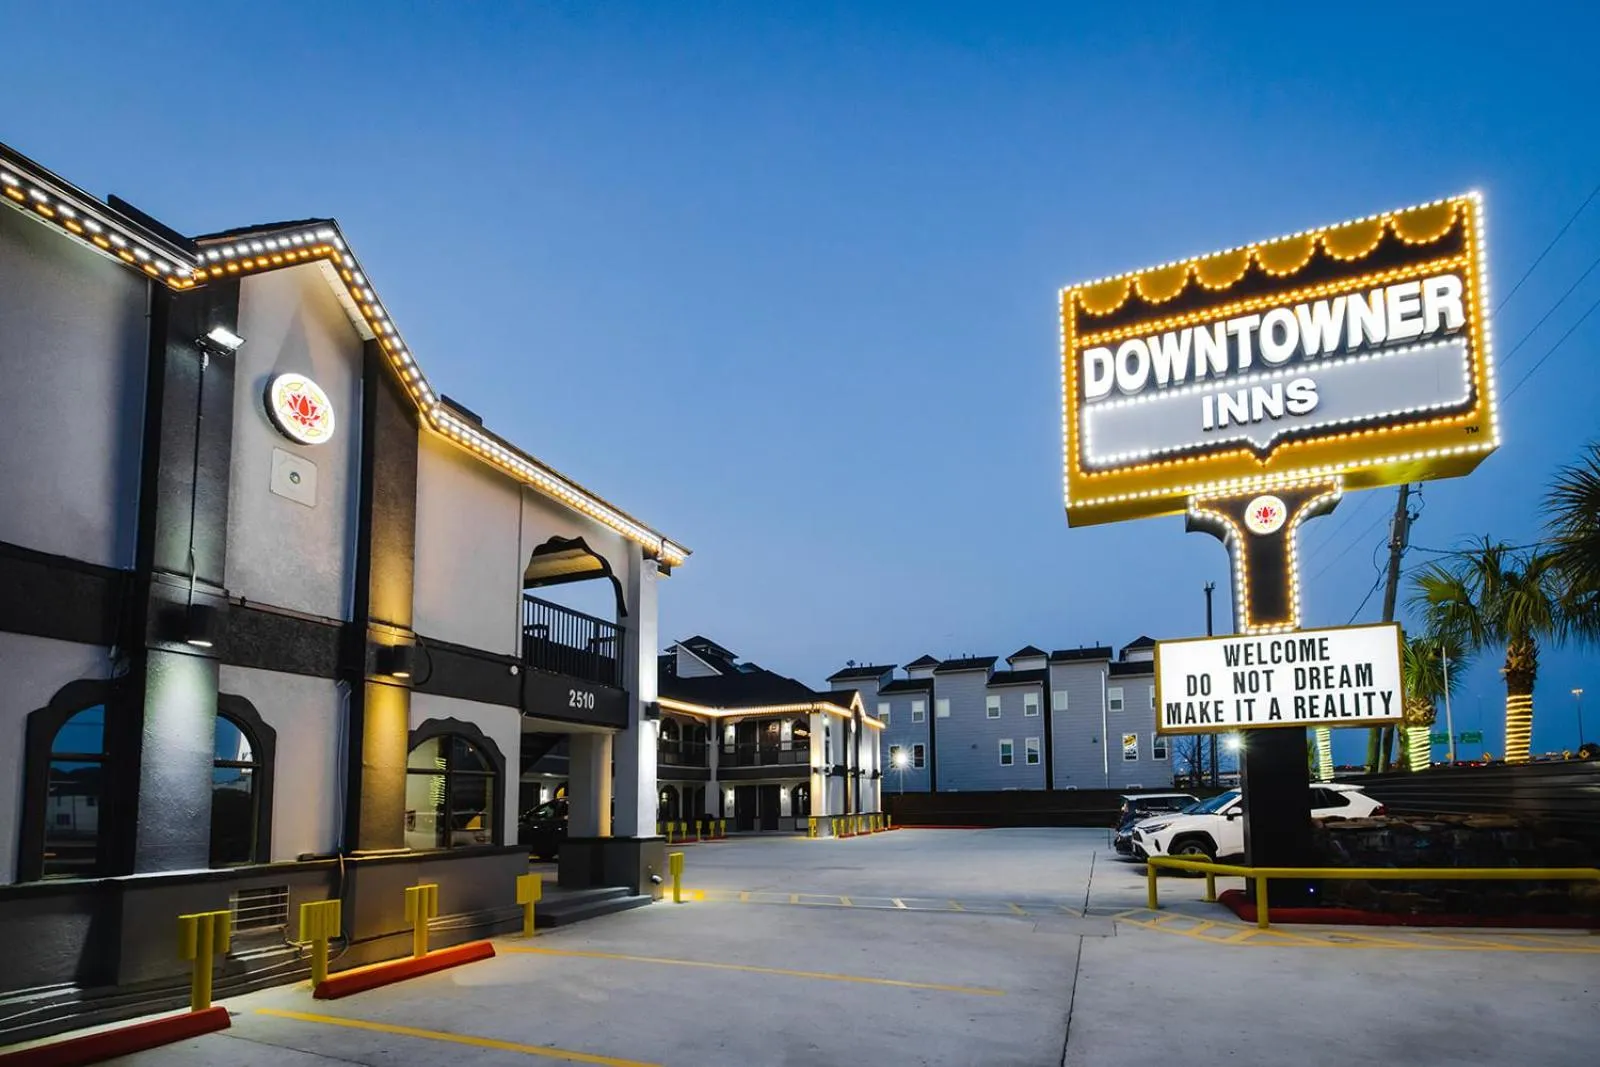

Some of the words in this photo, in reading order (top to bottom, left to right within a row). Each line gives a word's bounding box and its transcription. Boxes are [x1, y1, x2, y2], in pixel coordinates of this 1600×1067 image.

[1083, 274, 1466, 401] DOWNTOWNER
[1202, 378, 1320, 430] INNS
[1224, 637, 1330, 666] WELCOME
[1186, 673, 1212, 696] DO
[1233, 669, 1274, 694] NOT
[1294, 663, 1373, 691] DREAM
[569, 689, 594, 710] 2510
[1166, 700, 1224, 725] MAKE
[1236, 698, 1256, 722] IT
[1268, 697, 1282, 720] A
[1294, 690, 1393, 719] REALITY
